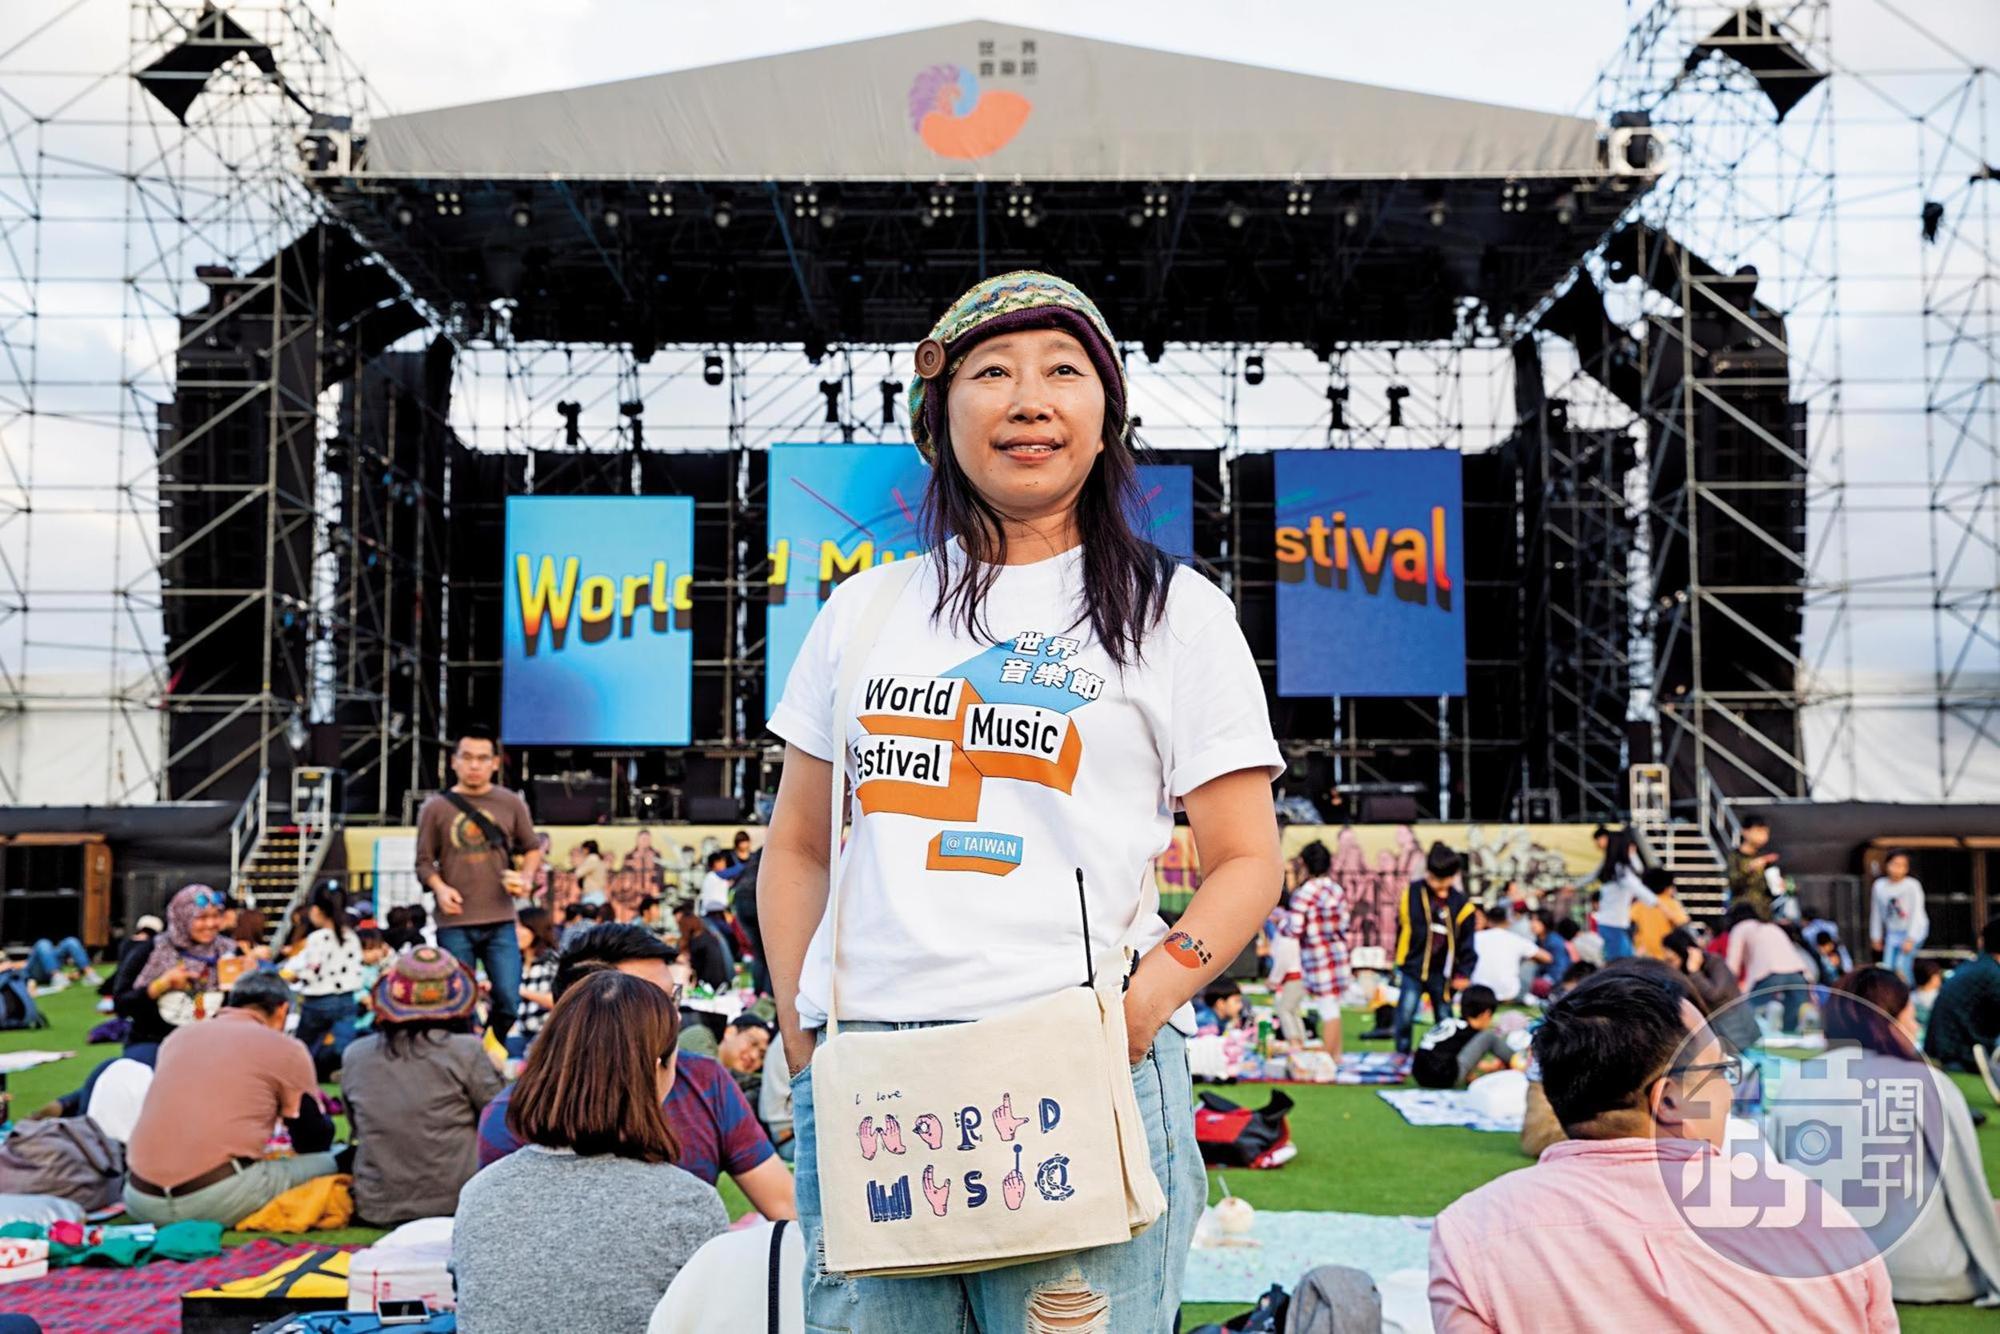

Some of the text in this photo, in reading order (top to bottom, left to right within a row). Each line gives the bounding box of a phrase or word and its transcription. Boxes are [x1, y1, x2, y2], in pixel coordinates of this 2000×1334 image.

[1274, 506, 1453, 592] stival
[1012, 631, 1081, 660] 世界
[864, 677, 955, 716] World
[999, 658, 1106, 701] 音樂節
[970, 706, 1059, 755] Music
[963, 836, 1017, 857] TAIWAN
